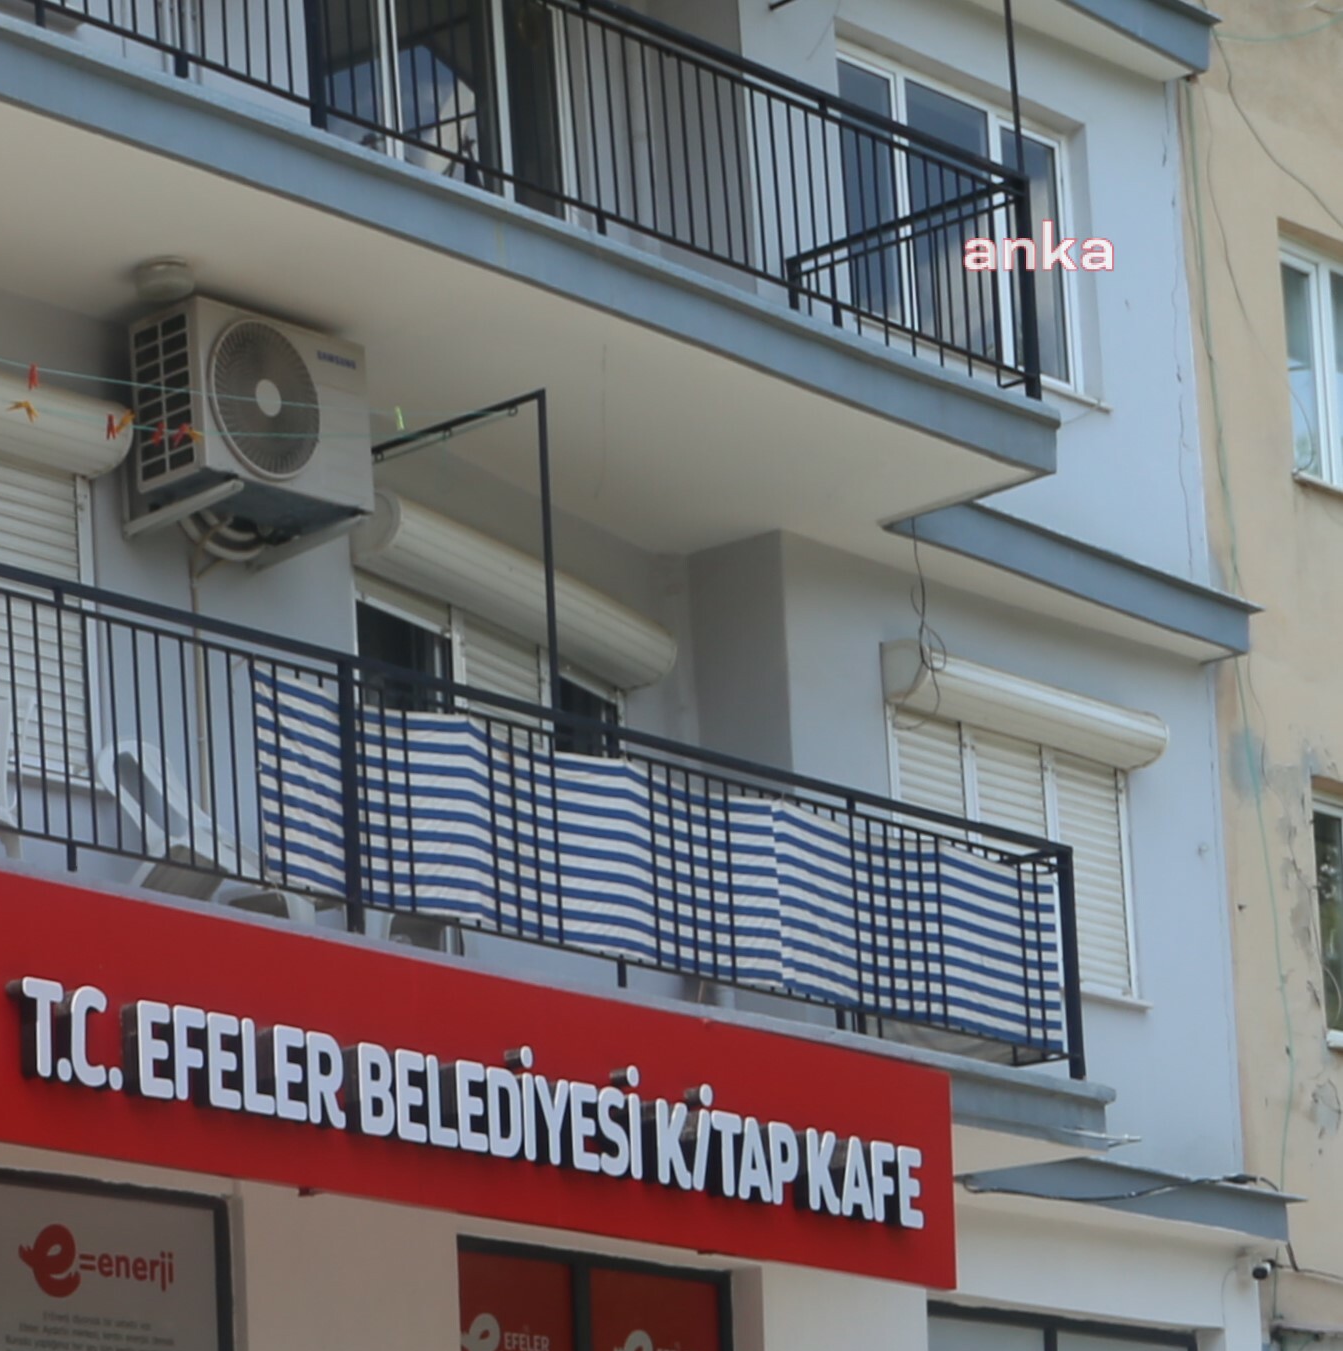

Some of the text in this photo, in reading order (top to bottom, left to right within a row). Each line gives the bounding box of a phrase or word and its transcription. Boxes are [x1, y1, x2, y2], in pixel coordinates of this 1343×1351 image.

[22, 975, 925, 1229] T.C. EFELER BELEDİYESİ KİTAP KAFE
